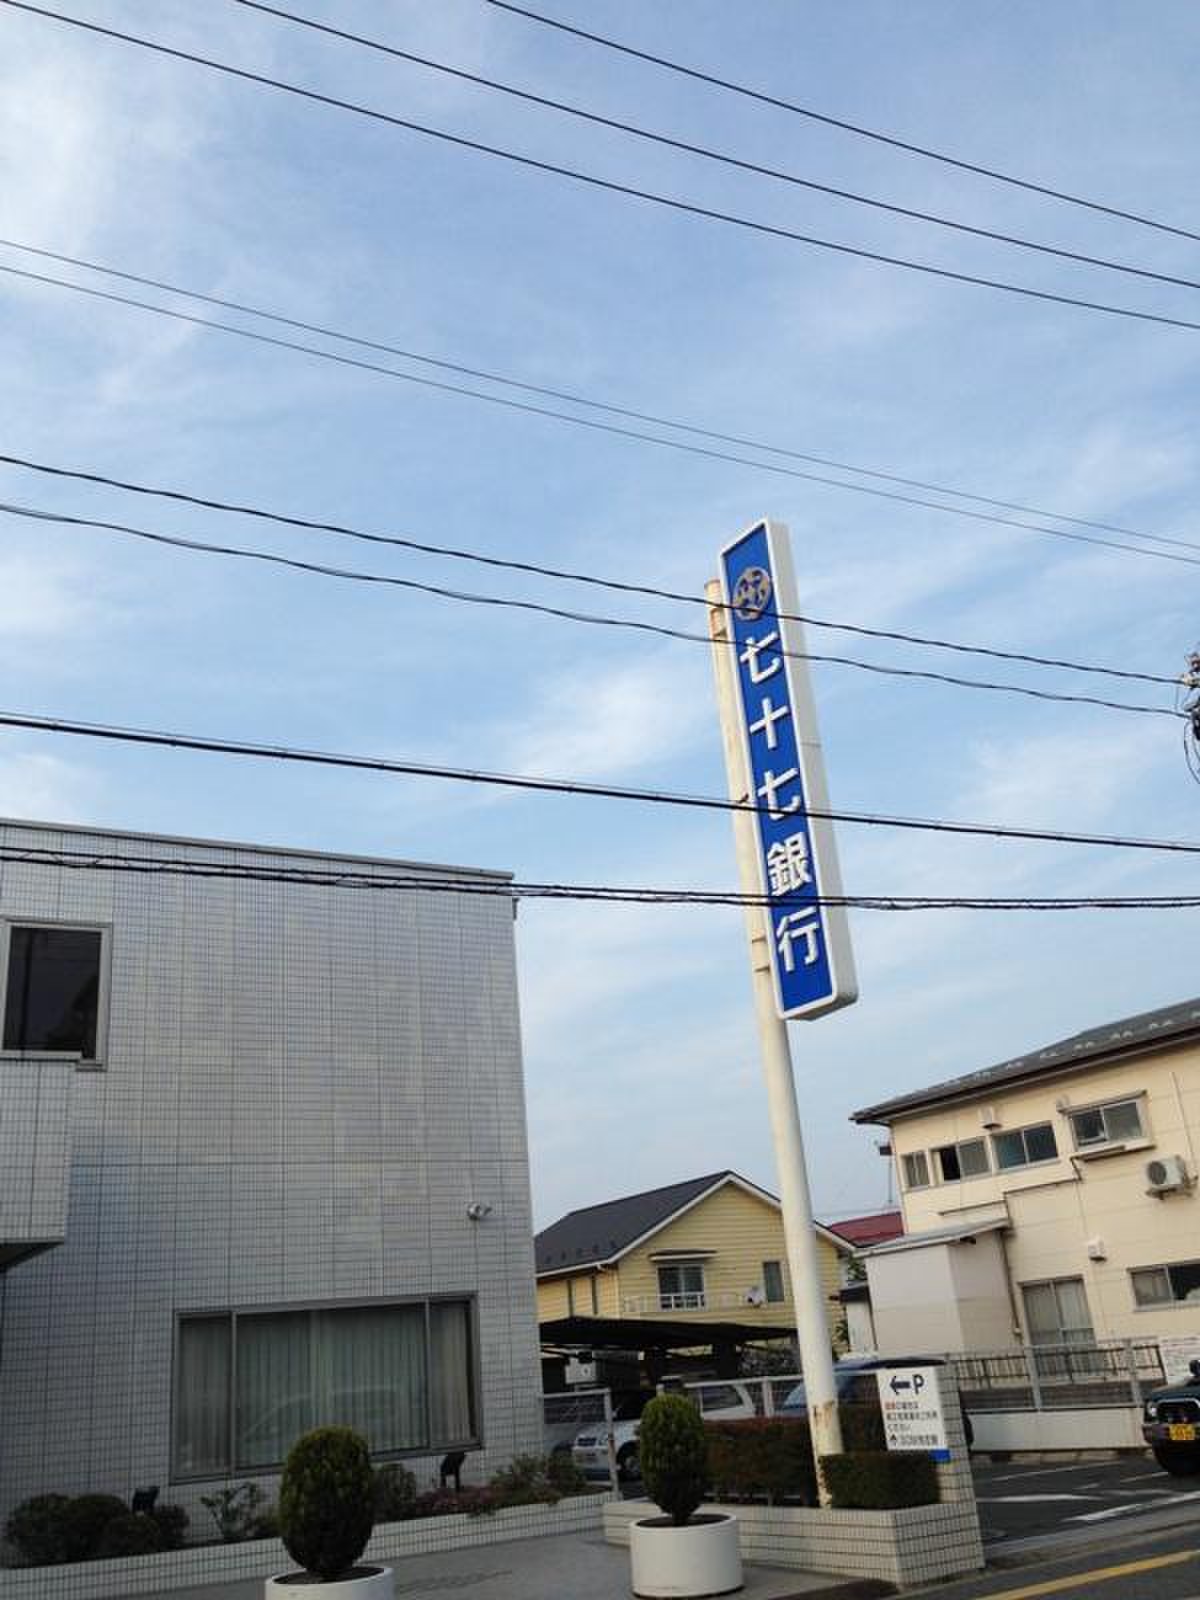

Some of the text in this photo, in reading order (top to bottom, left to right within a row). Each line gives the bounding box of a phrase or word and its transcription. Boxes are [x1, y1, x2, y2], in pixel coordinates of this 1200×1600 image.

[739, 632, 820, 972] 七十七銀行
[912, 1374, 925, 1395] P
